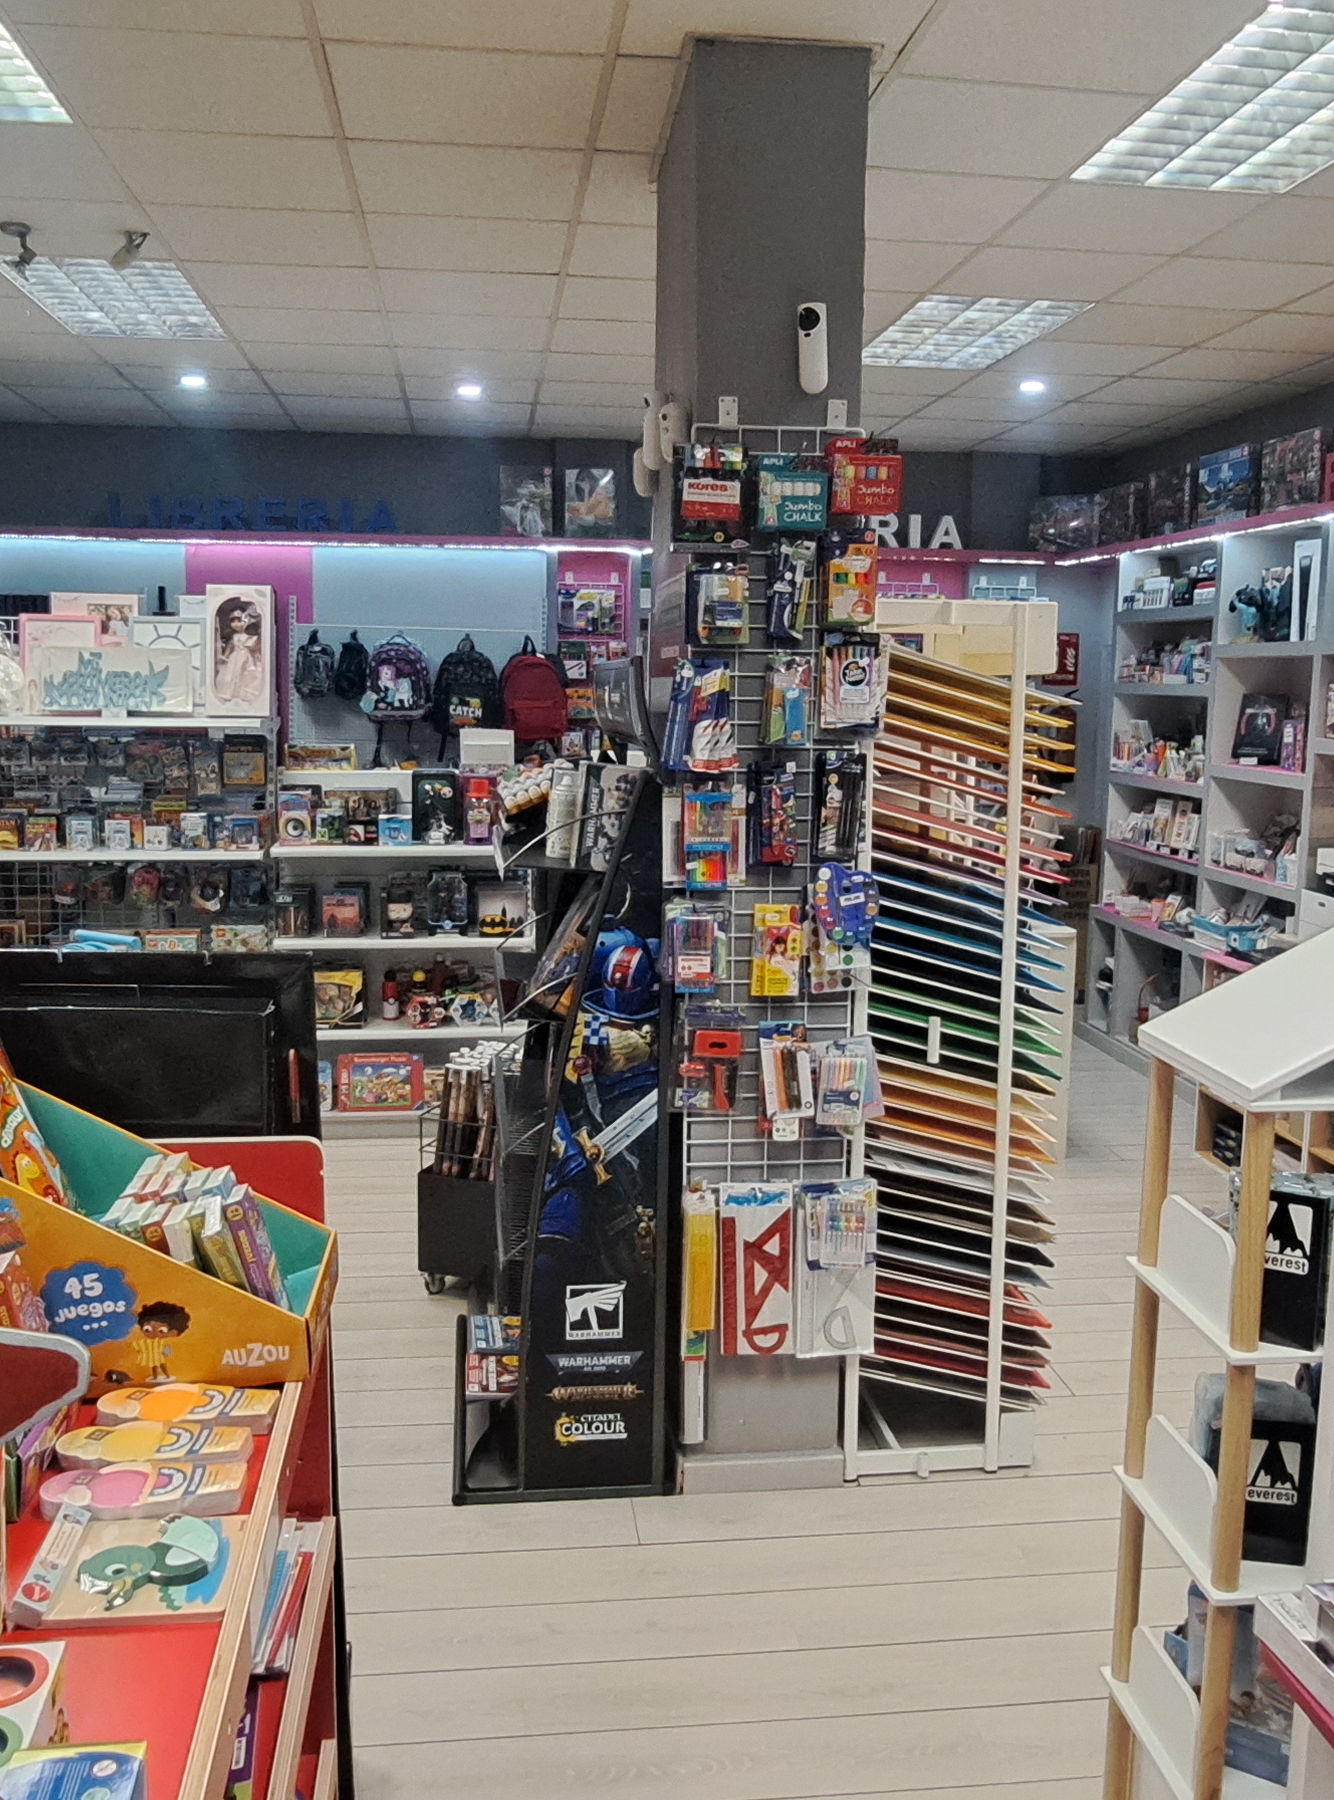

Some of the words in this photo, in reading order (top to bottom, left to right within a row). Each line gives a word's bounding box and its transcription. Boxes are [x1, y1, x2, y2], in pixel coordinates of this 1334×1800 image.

[835, 439, 856, 449] APLI
[763, 457, 784, 466] APLI
[857, 484, 895, 495] Jumbo
[107, 490, 398, 534] LIBRERIA
[784, 500, 823, 512] Jumbo
[783, 511, 822, 522] CHALK
[870, 514, 963, 549] RIA
[449, 704, 483, 719] CATCH
[1265, 1252, 1307, 1275] verest
[64, 1273, 104, 1300] 45
[53, 1300, 127, 1325] juegos
[568, 1330, 622, 1338] WARHAMMER
[222, 1342, 290, 1369] AUZOU
[557, 1355, 632, 1367] WARHAMMER
[580, 1413, 623, 1422] CITADEL
[561, 1422, 626, 1435] COLOUR
[1247, 1486, 1297, 1504] everest
